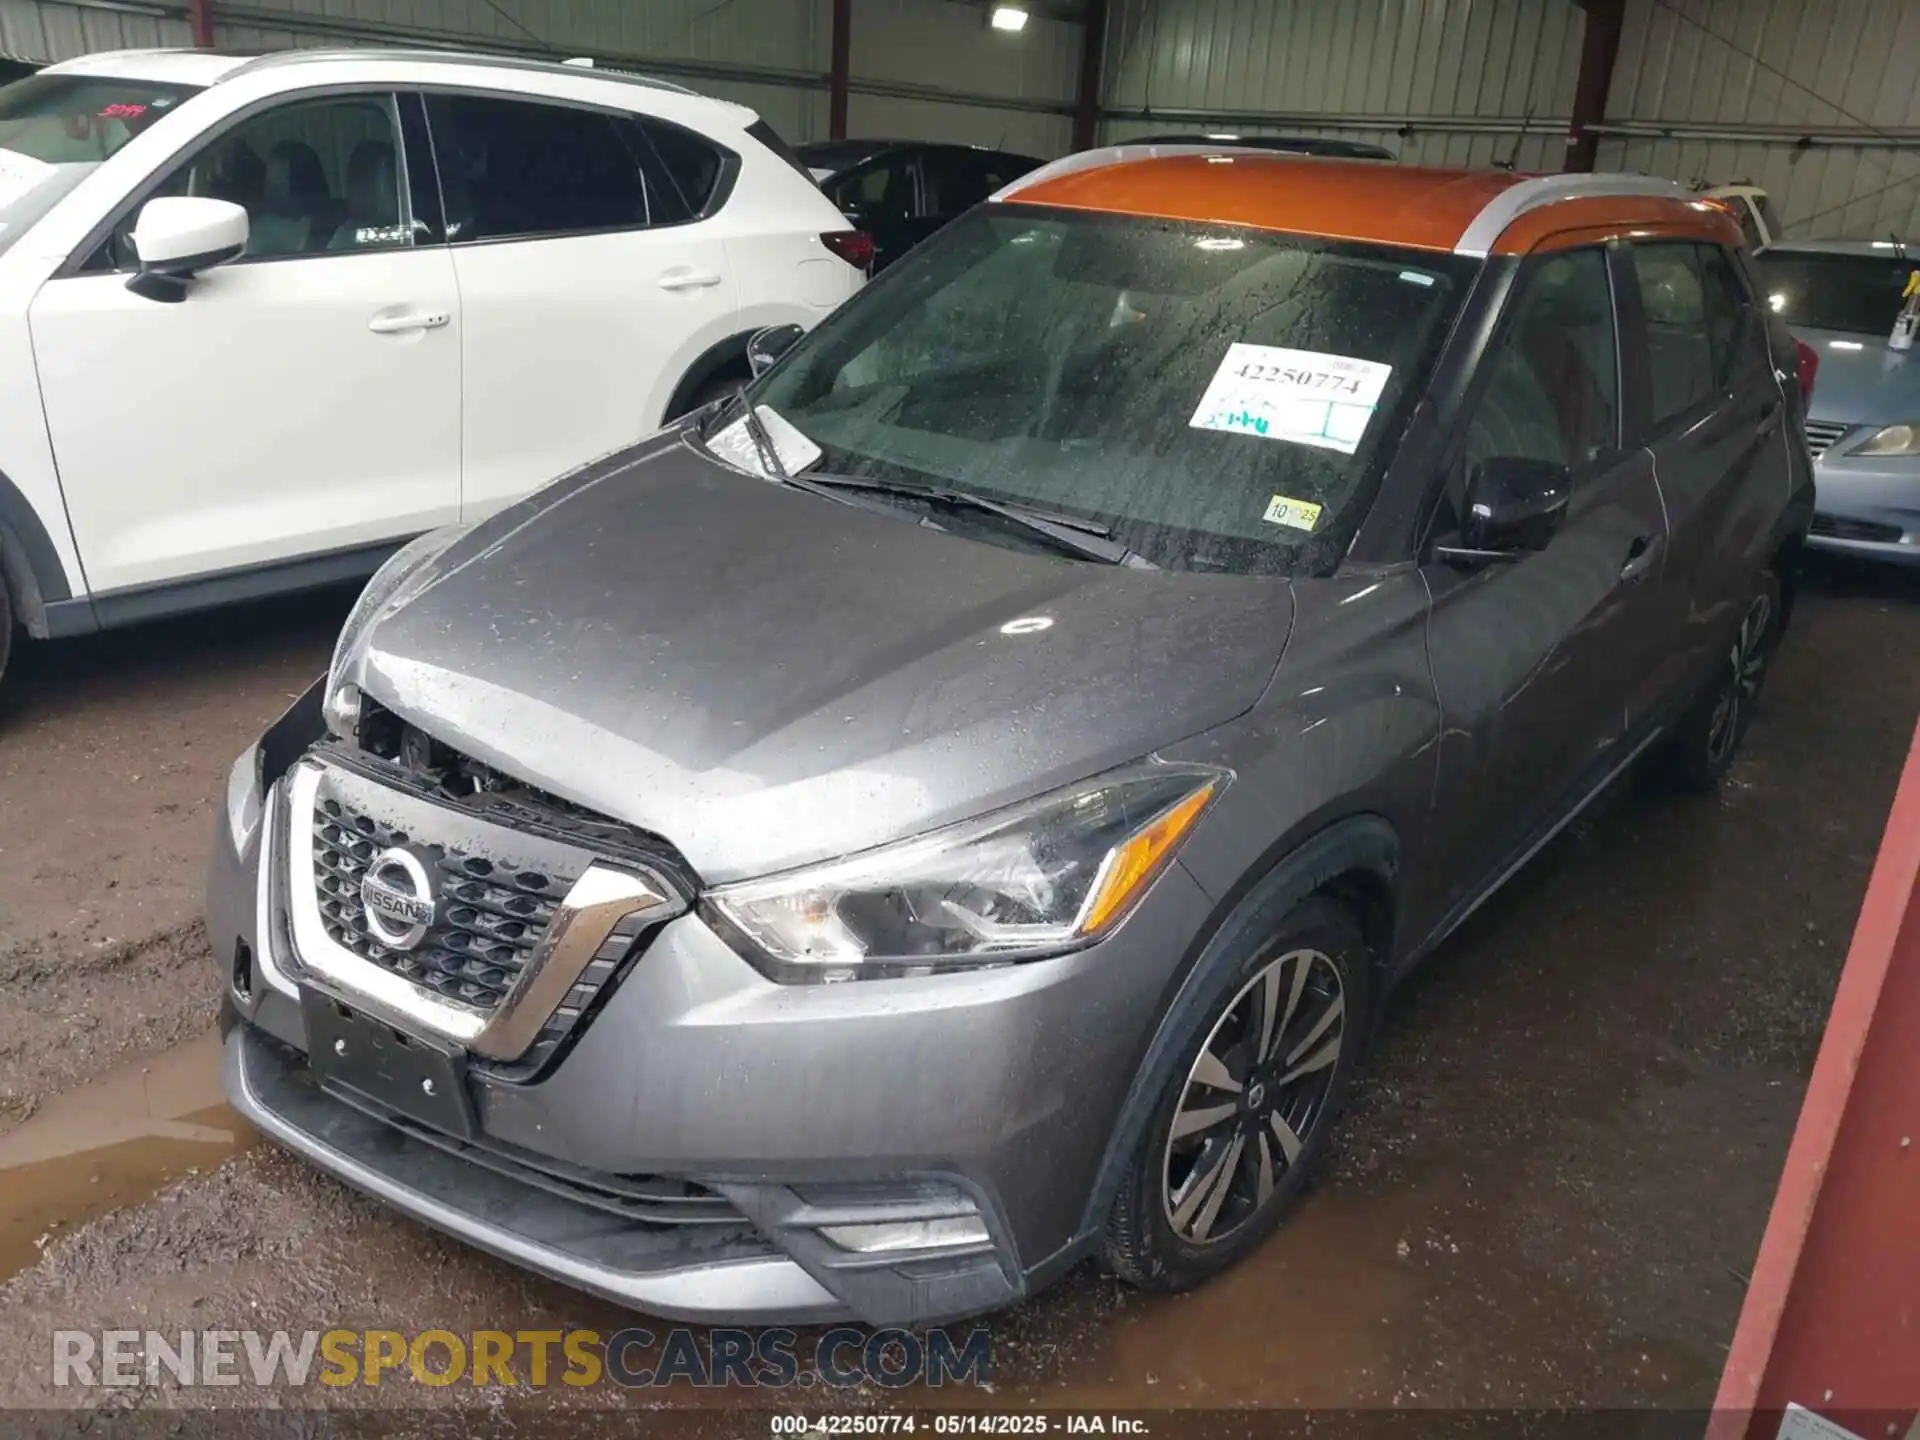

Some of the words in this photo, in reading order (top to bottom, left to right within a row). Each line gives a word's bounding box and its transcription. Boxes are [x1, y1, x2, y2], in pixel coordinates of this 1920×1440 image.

[1234, 364, 1362, 395] 42250774
[1272, 503, 1288, 518] 10
[1301, 508, 1317, 521] 25
[363, 884, 420, 918] NISSAN
